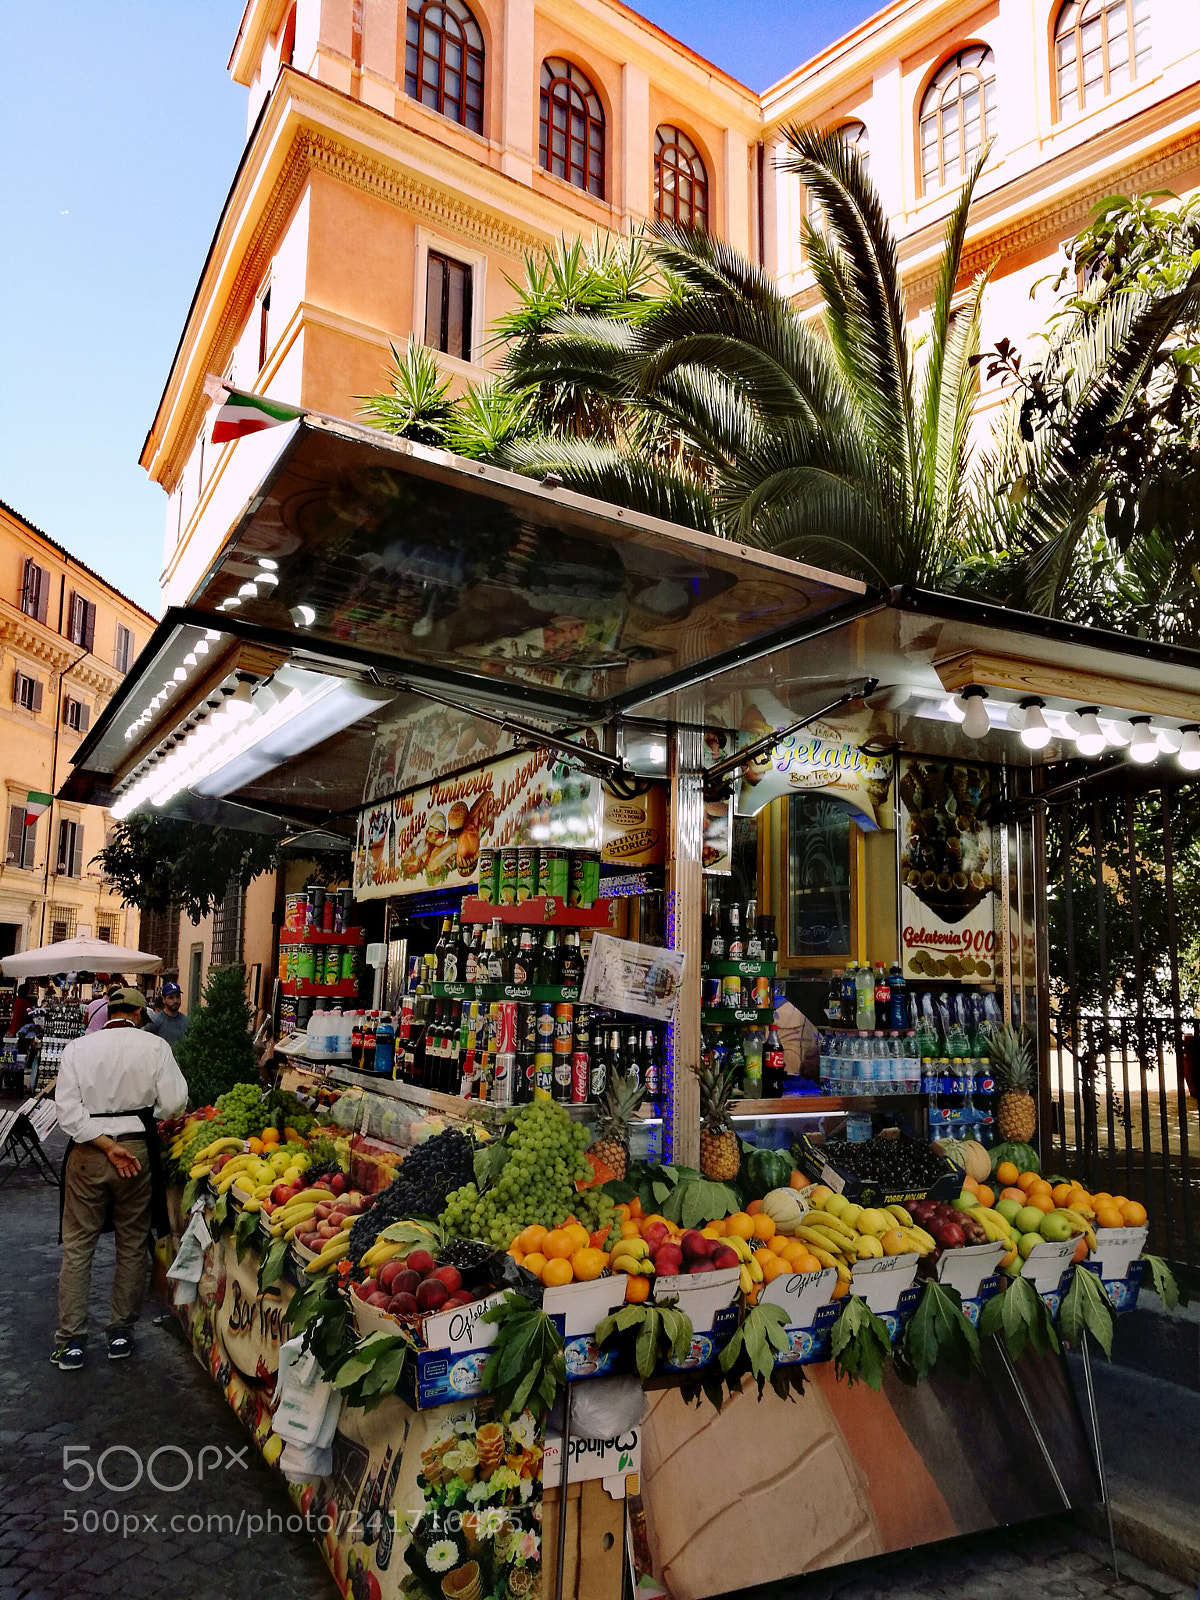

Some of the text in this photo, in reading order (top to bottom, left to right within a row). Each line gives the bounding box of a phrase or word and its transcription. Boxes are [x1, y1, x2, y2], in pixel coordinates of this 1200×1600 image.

[771, 729, 862, 771] Gelati
[789, 769, 838, 782] Bar Trevi
[428, 769, 494, 809] Panineria
[394, 793, 414, 820] Vini
[397, 812, 427, 859] Bibite
[609, 838, 653, 855] STORICA
[903, 926, 994, 952] Gelateria 900
[739, 962, 761, 973] Carlsberg
[504, 985, 532, 998] Carlsberg
[734, 1010, 758, 1021] Carlsberg
[229, 1279, 257, 1334] Bar
